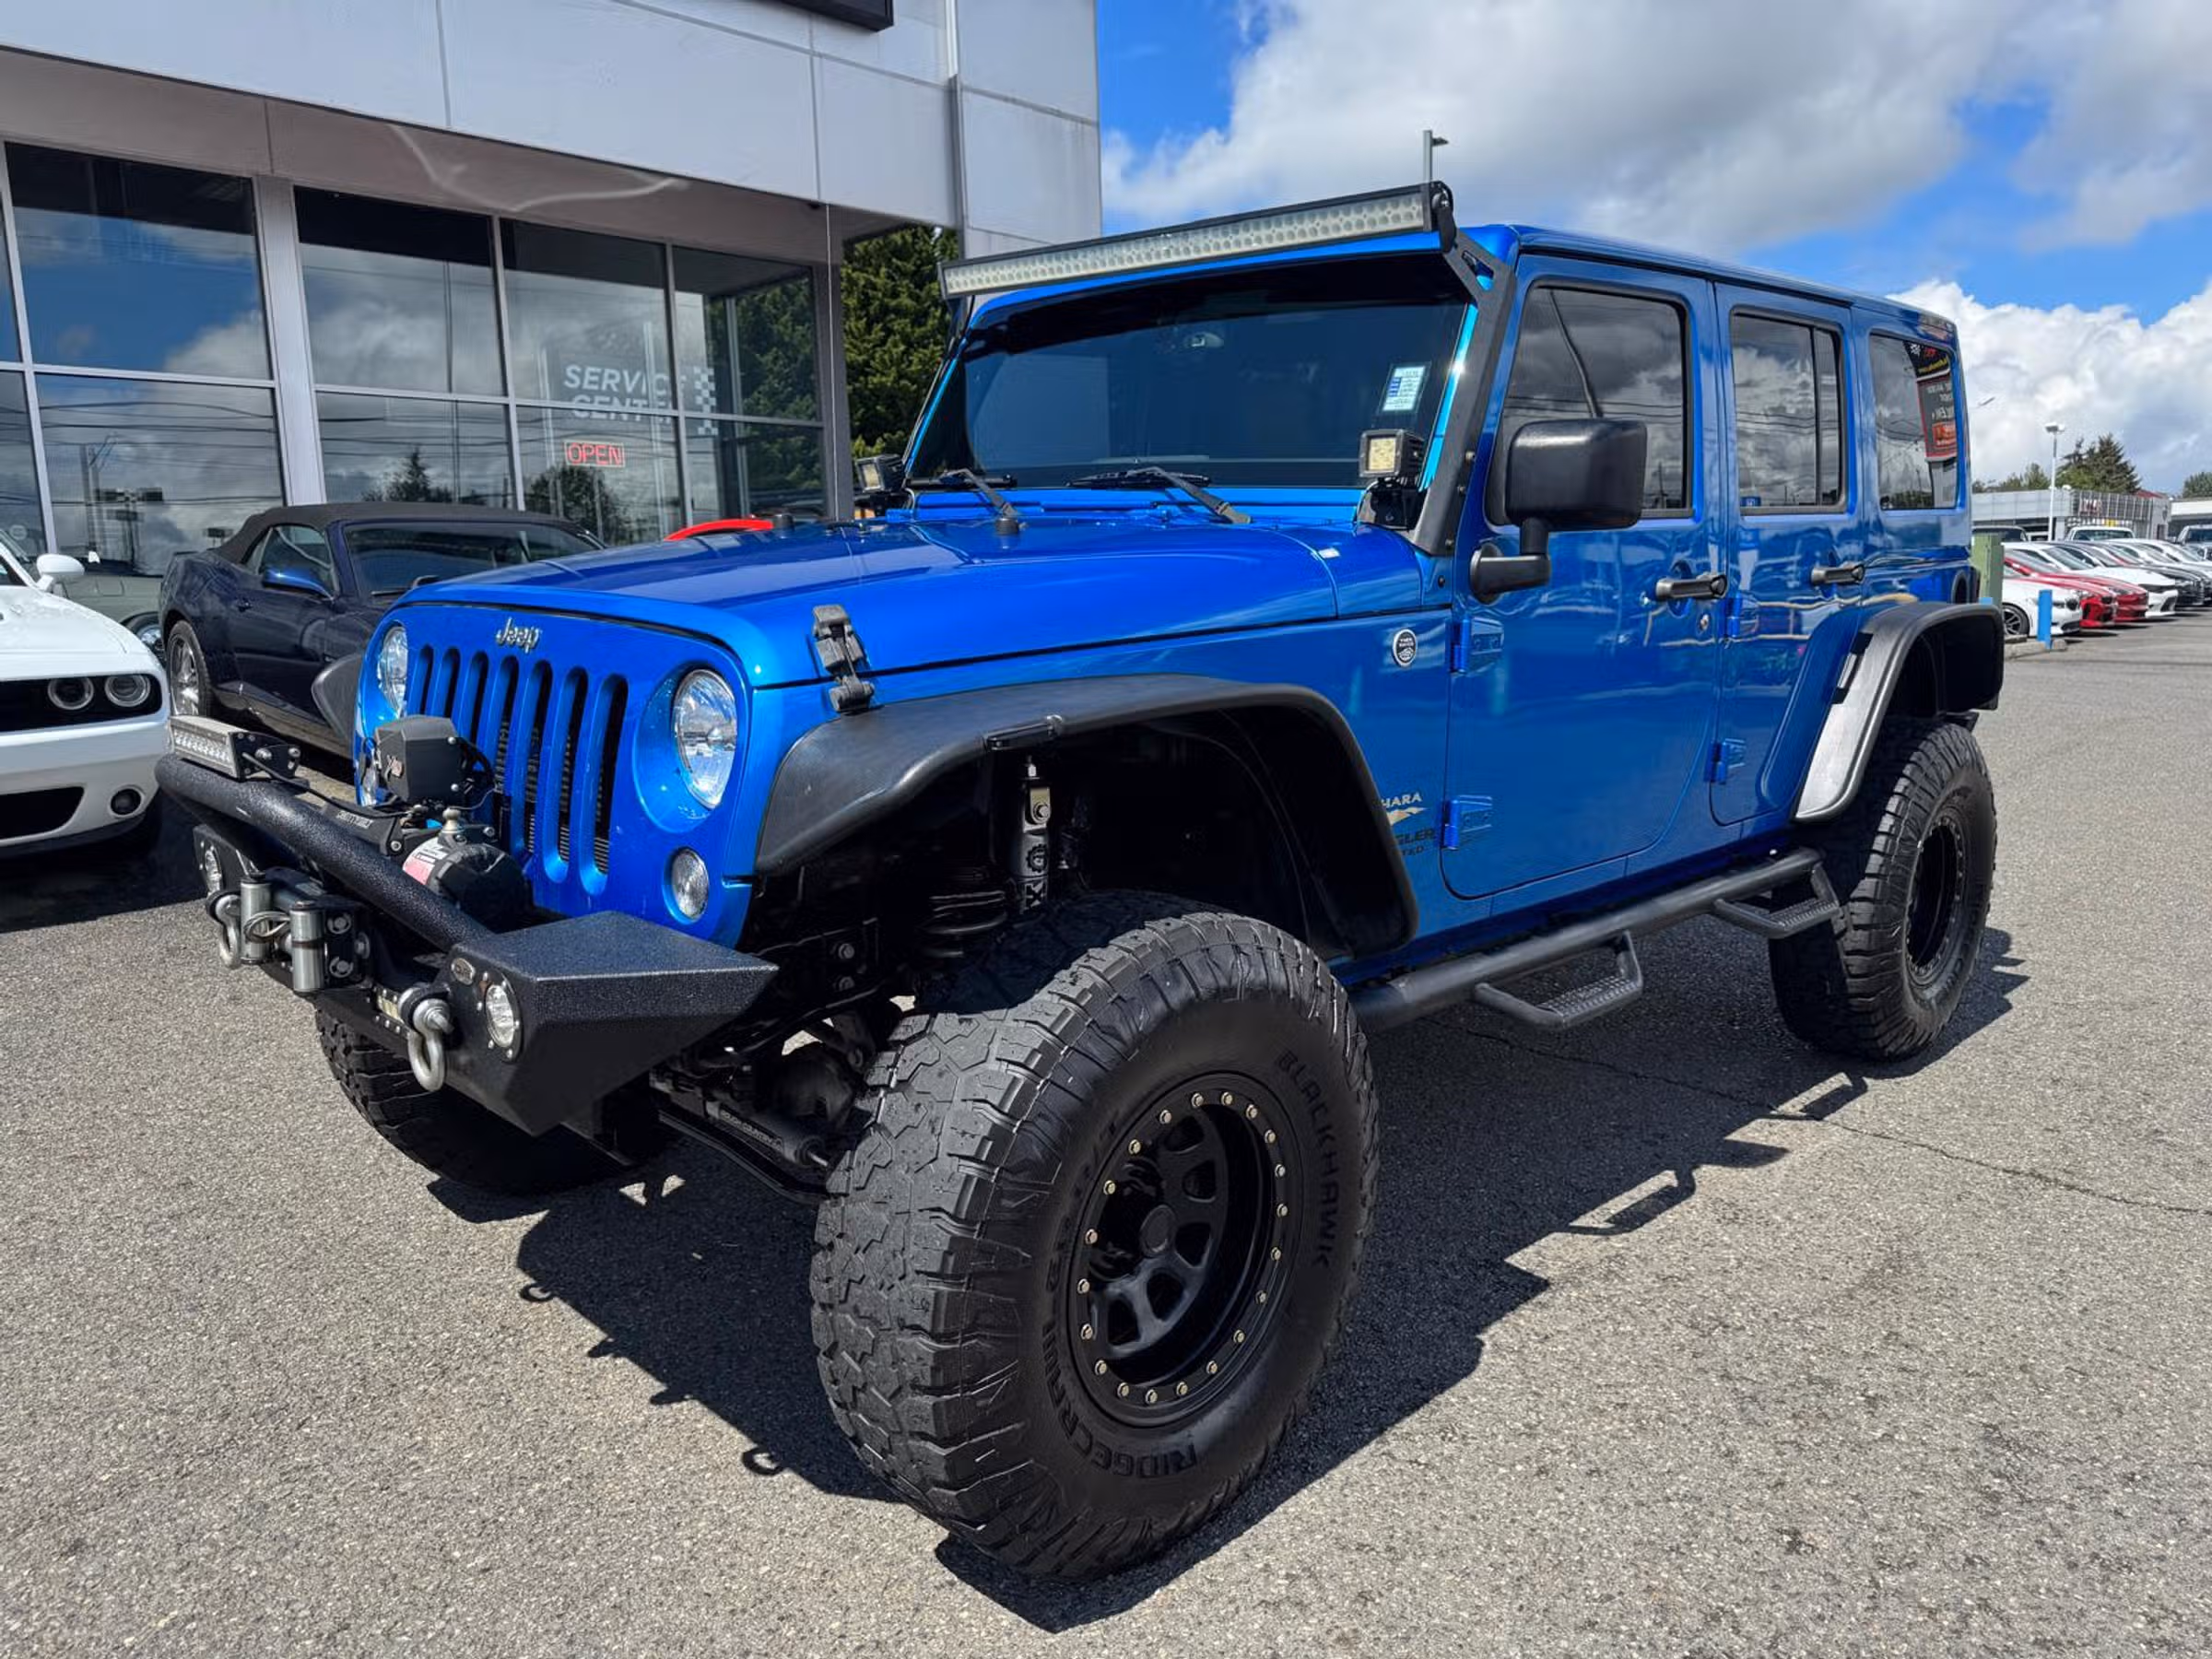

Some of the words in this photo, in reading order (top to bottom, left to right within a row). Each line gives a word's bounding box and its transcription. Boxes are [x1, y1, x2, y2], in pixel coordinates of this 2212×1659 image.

[568, 442, 622, 465] OPEN
[496, 616, 540, 653] Jeep
[1381, 792, 1422, 807] HARA
[1277, 1051, 1338, 1268] BLACKHAWK
